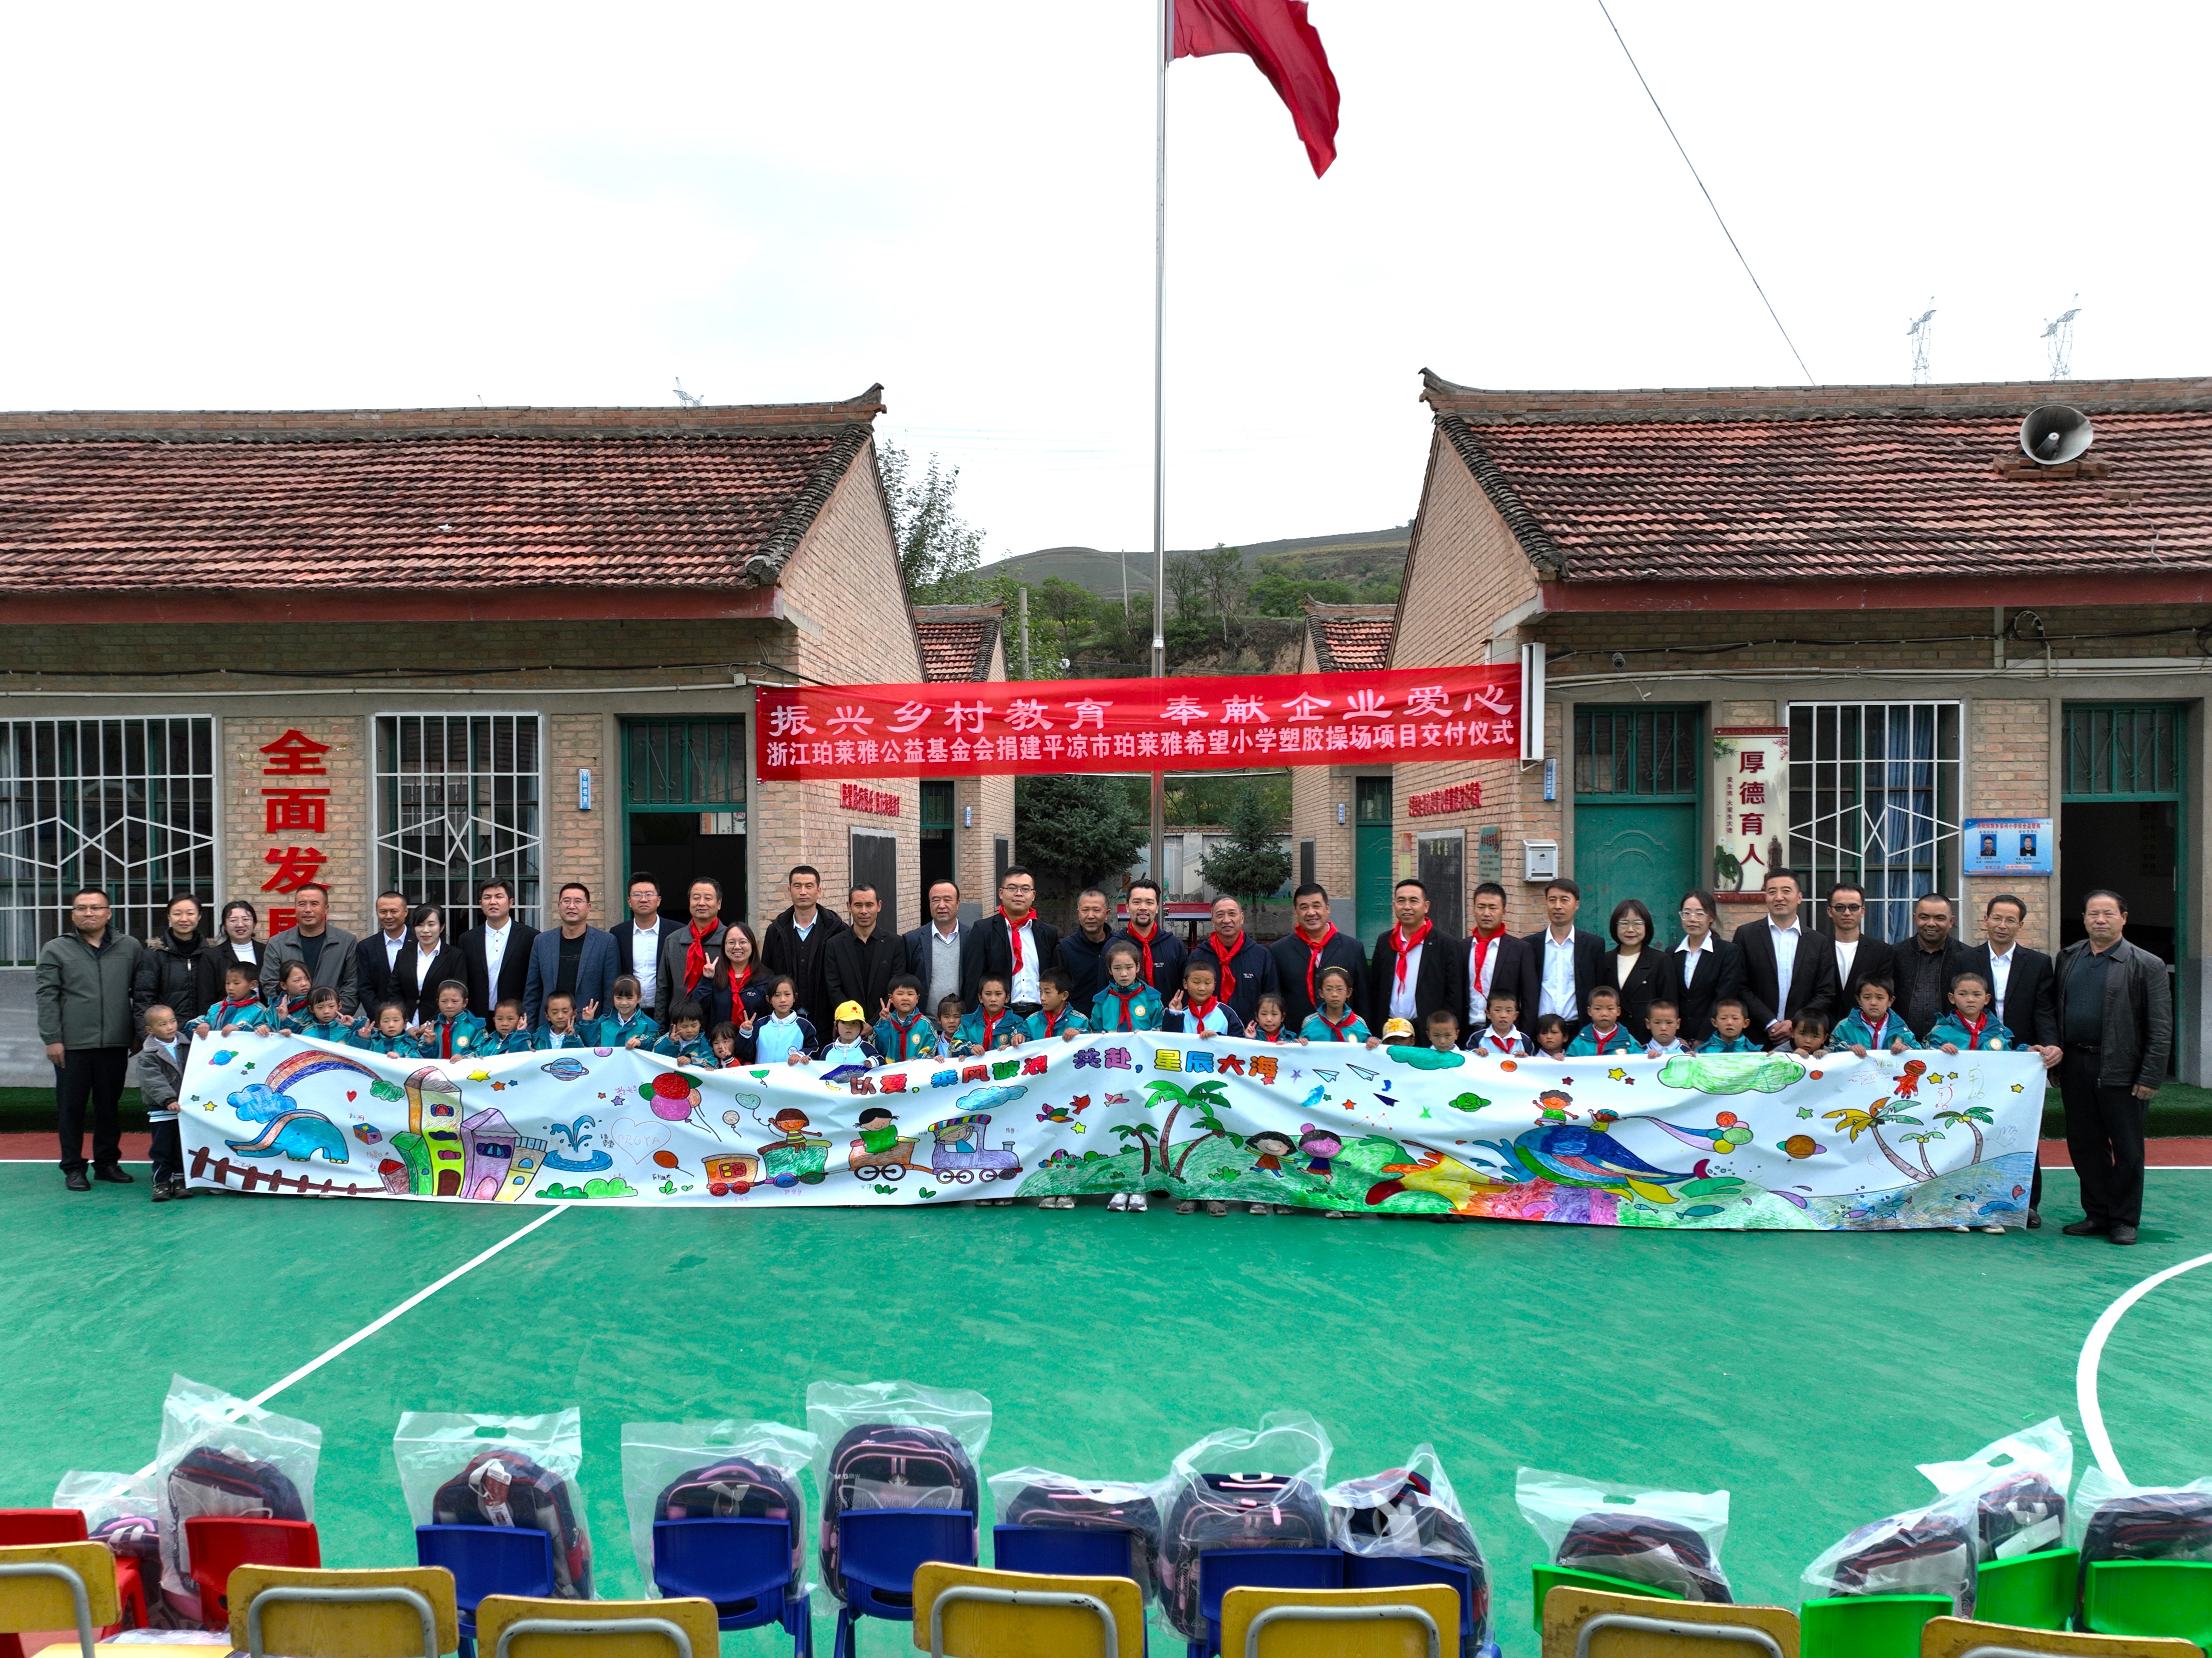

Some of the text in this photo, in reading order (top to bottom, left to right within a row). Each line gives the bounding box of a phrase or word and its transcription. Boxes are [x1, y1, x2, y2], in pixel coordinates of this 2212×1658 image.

[769, 684, 1515, 737] 振兴乡村教育 奉献企业爱心
[767, 719, 1514, 767] 浙江珀莱雅公益基金会捐建平凉市珀莱雅希望小学塑胶操场项目交付仪式
[1739, 751, 1765, 866] 厚德育人
[850, 1047, 1278, 1095] 以爱，乘风破浪 共赴，星辰大海
